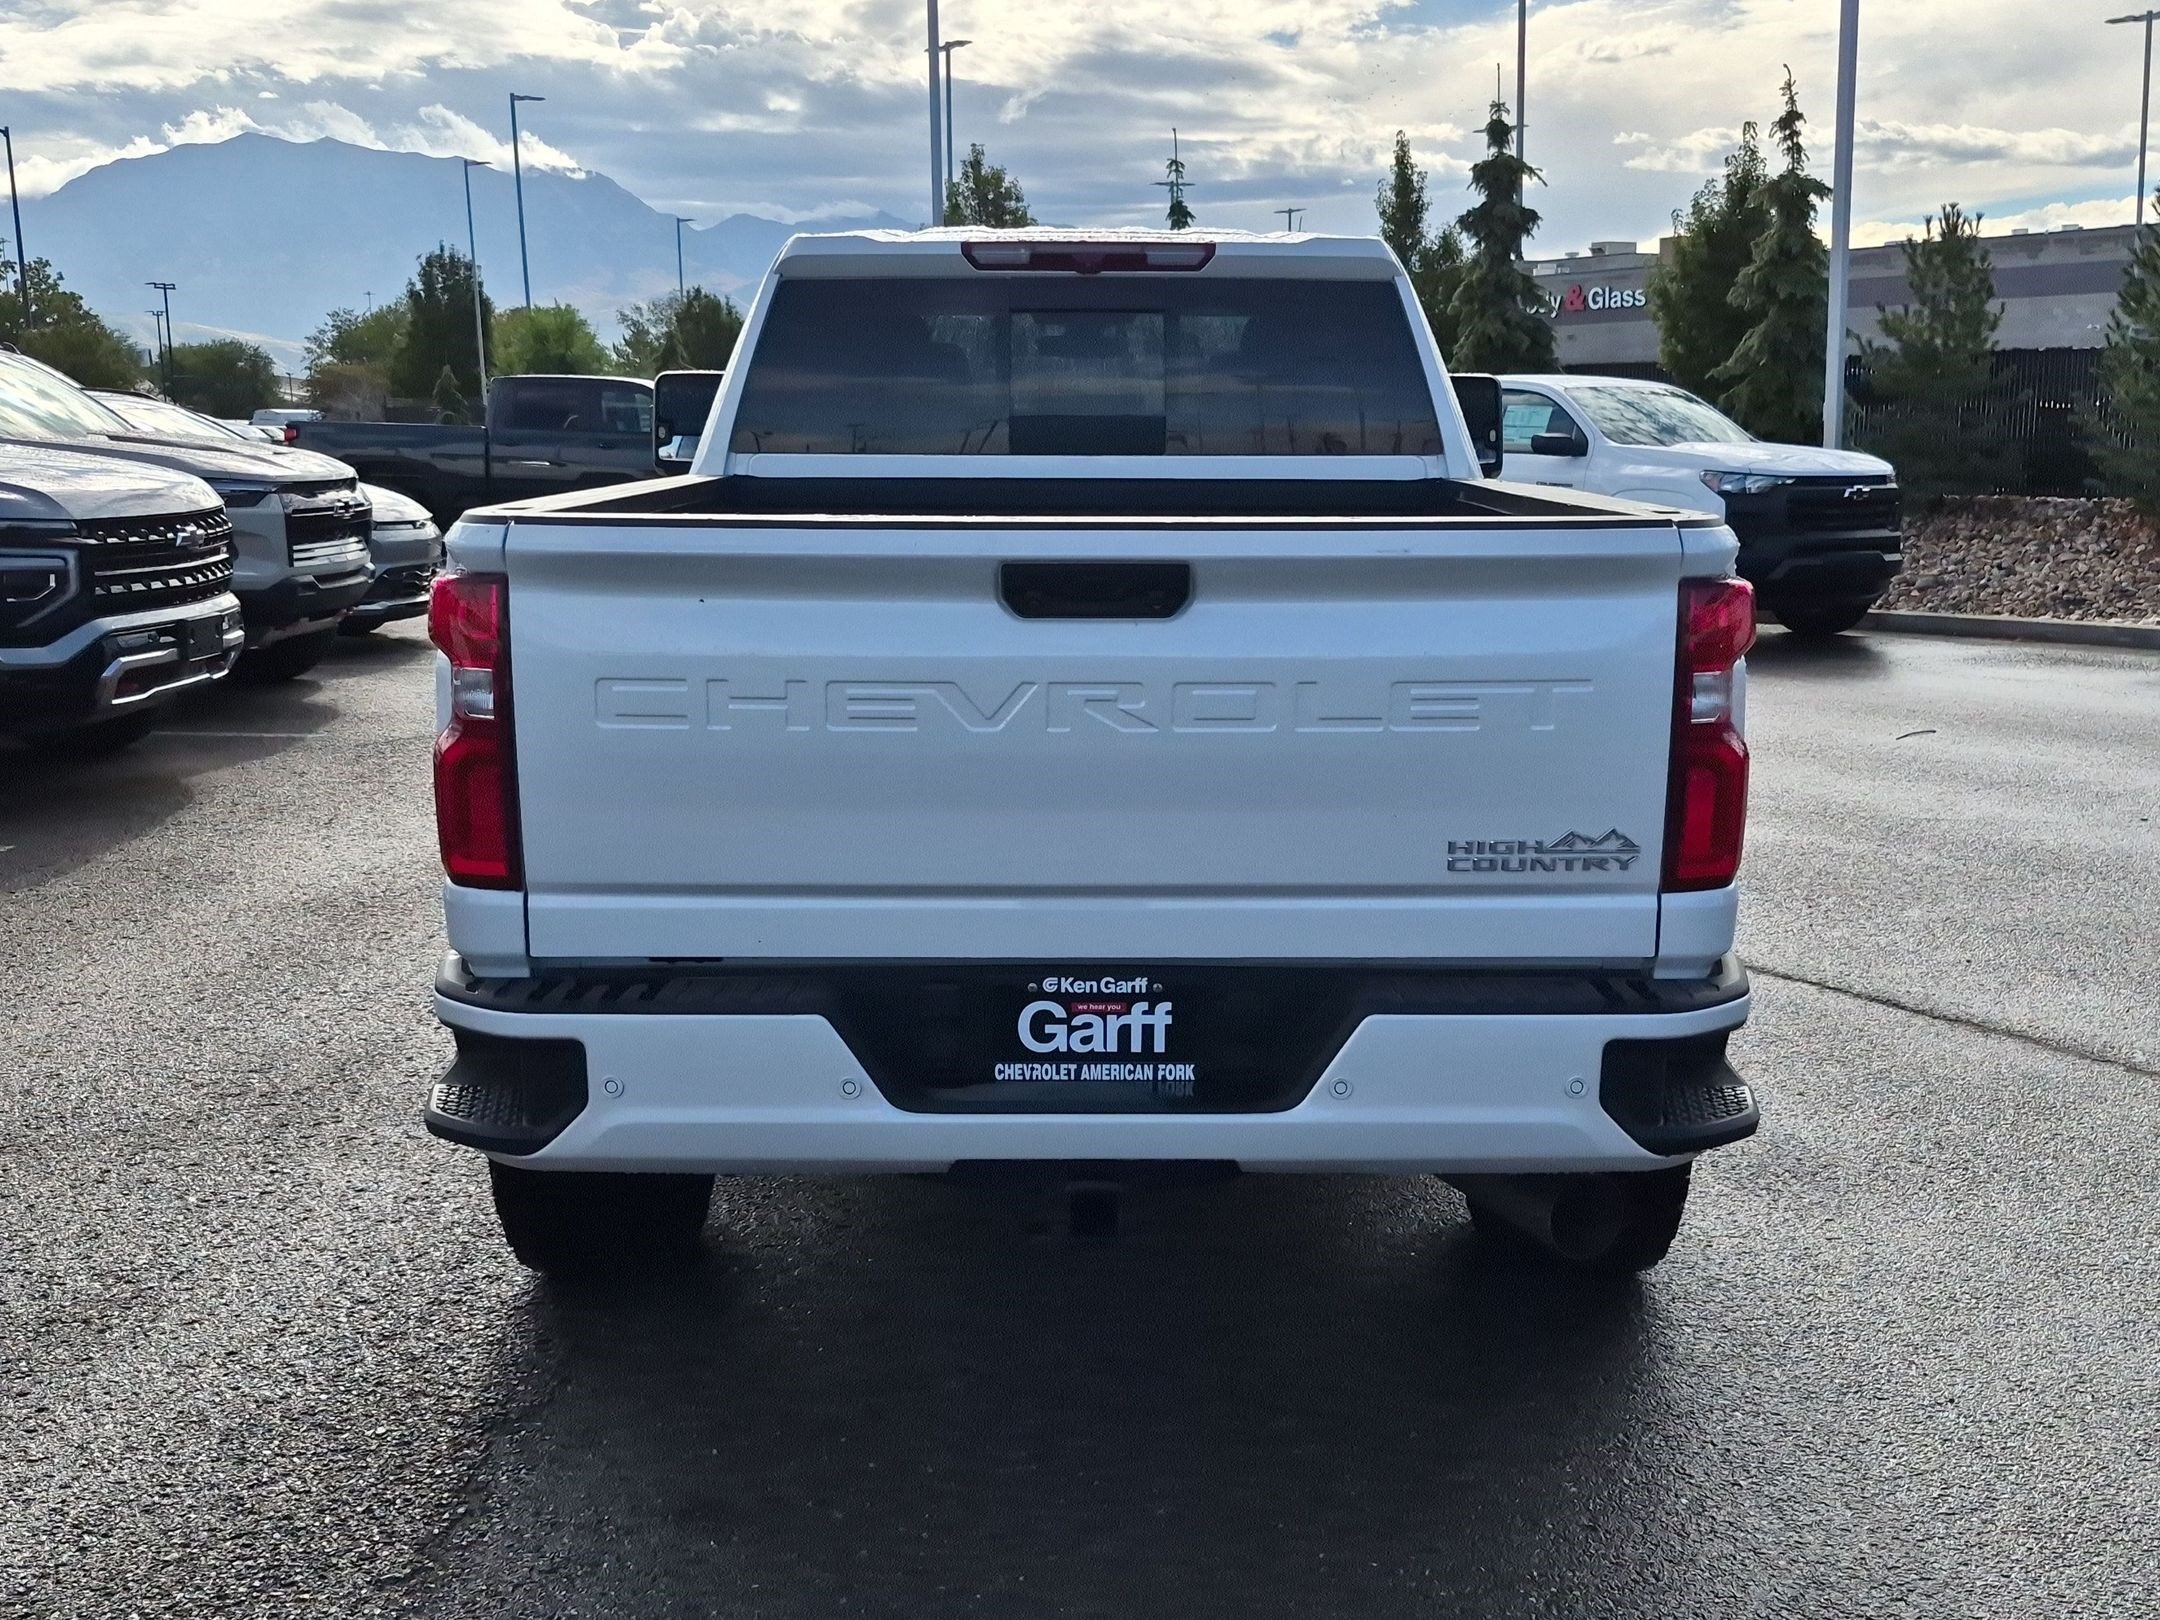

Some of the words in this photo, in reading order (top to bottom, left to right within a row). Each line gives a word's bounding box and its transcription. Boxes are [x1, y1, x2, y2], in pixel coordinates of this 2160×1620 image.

[1566, 285, 1586, 311] &
[1588, 286, 1647, 310] Glass
[595, 677, 1594, 733] CHEVROLET
[1447, 840, 1546, 855] HIGH
[1447, 856, 1640, 872] COUNTRY
[1060, 977, 1098, 993] Ken
[1100, 977, 1148, 993] Garff
[1017, 1000, 1172, 1053] Garff
[994, 1063, 1077, 1081] CHEVROLET
[1080, 1063, 1153, 1081] AMERICAN
[1157, 1063, 1195, 1081] FORK
